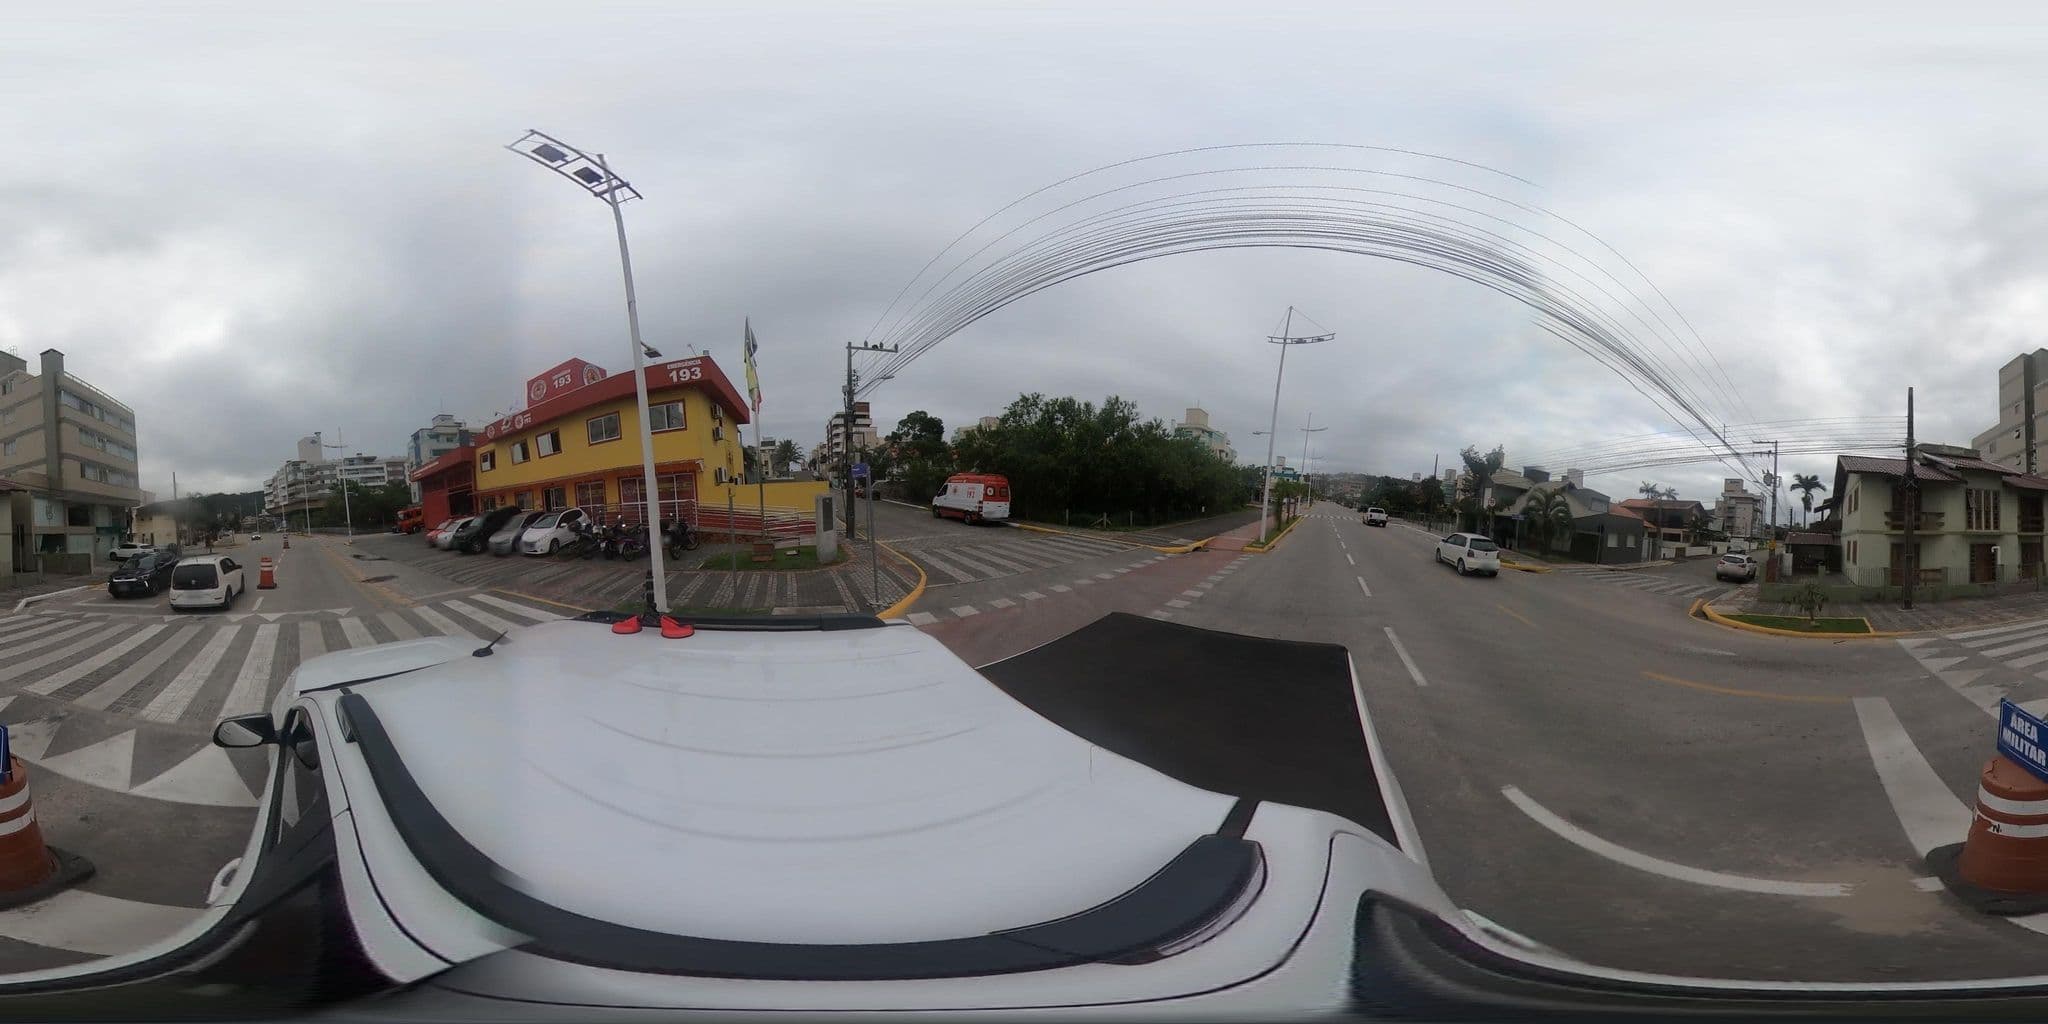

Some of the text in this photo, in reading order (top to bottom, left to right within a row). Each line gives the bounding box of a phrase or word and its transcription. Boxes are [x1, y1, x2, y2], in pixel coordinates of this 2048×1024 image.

[553, 374, 571, 388] 193
[669, 367, 702, 383] 193
[2002, 727, 2046, 767] MILITAR
